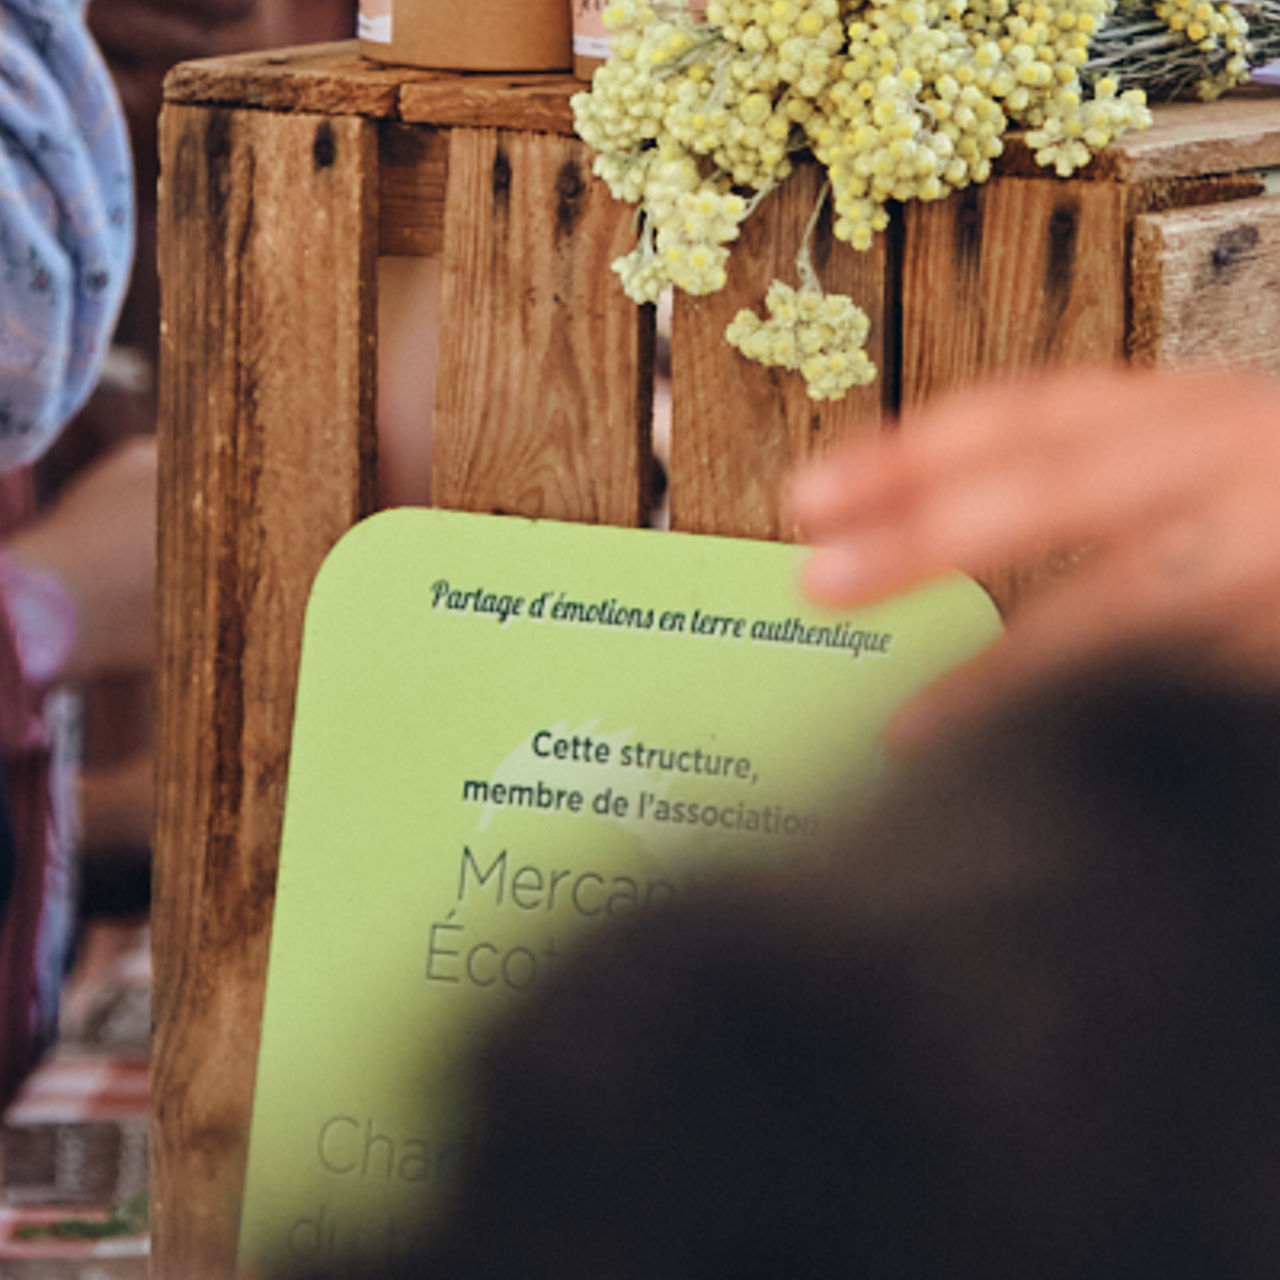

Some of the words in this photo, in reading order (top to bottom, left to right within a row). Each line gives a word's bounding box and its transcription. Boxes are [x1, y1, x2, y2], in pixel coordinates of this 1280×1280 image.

[430, 579, 525, 624] Partage
[528, 589, 655, 629] d'émotions
[659, 609, 686, 633] en
[691, 608, 747, 638] terre
[751, 617, 893, 658] authentique
[532, 730, 611, 764] Cette
[620, 741, 760, 786] structure,
[463, 778, 584, 813] membre
[592, 787, 630, 818] de
[638, 790, 819, 839] l'association
[457, 845, 680, 922] Mercan
